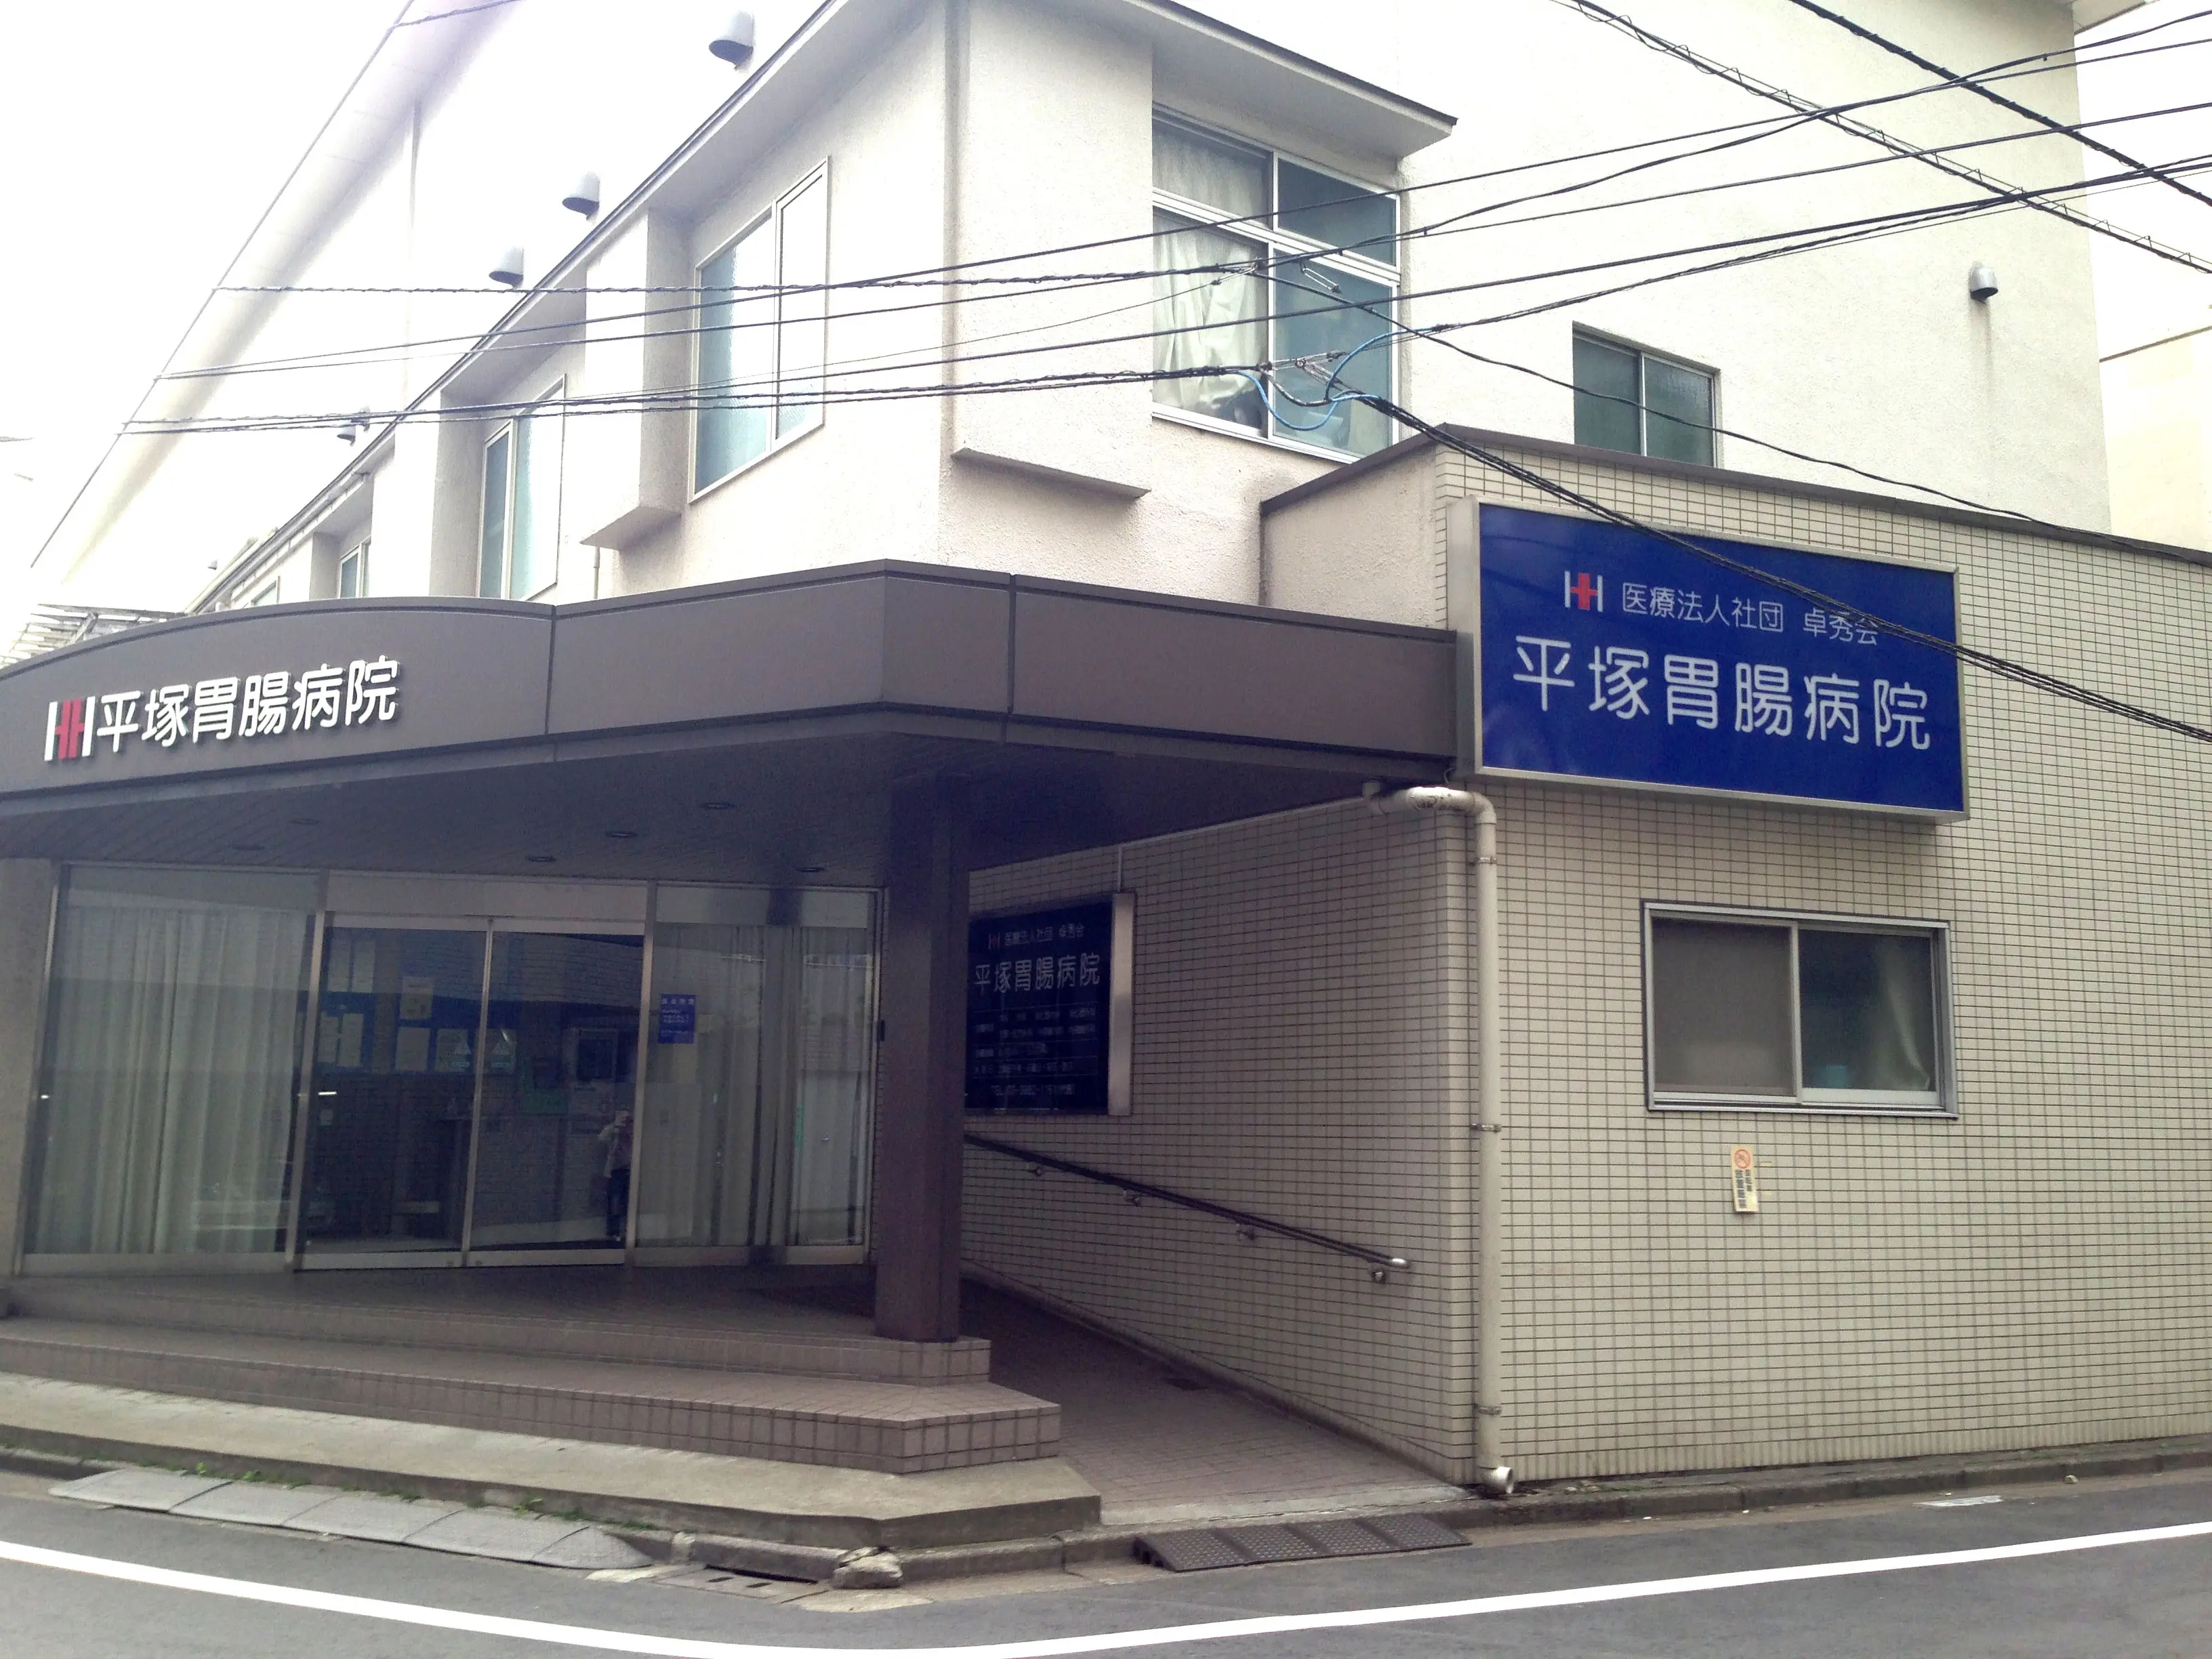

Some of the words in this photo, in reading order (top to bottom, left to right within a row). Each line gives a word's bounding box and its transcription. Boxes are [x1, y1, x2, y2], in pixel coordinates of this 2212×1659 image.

[1622, 581, 1784, 633] 医療法人社団
[96, 655, 400, 753] 平塚胃腸病院
[1513, 634, 1930, 750] 平塚胃腸病院
[974, 951, 1101, 996] 平塚胃腸病院
